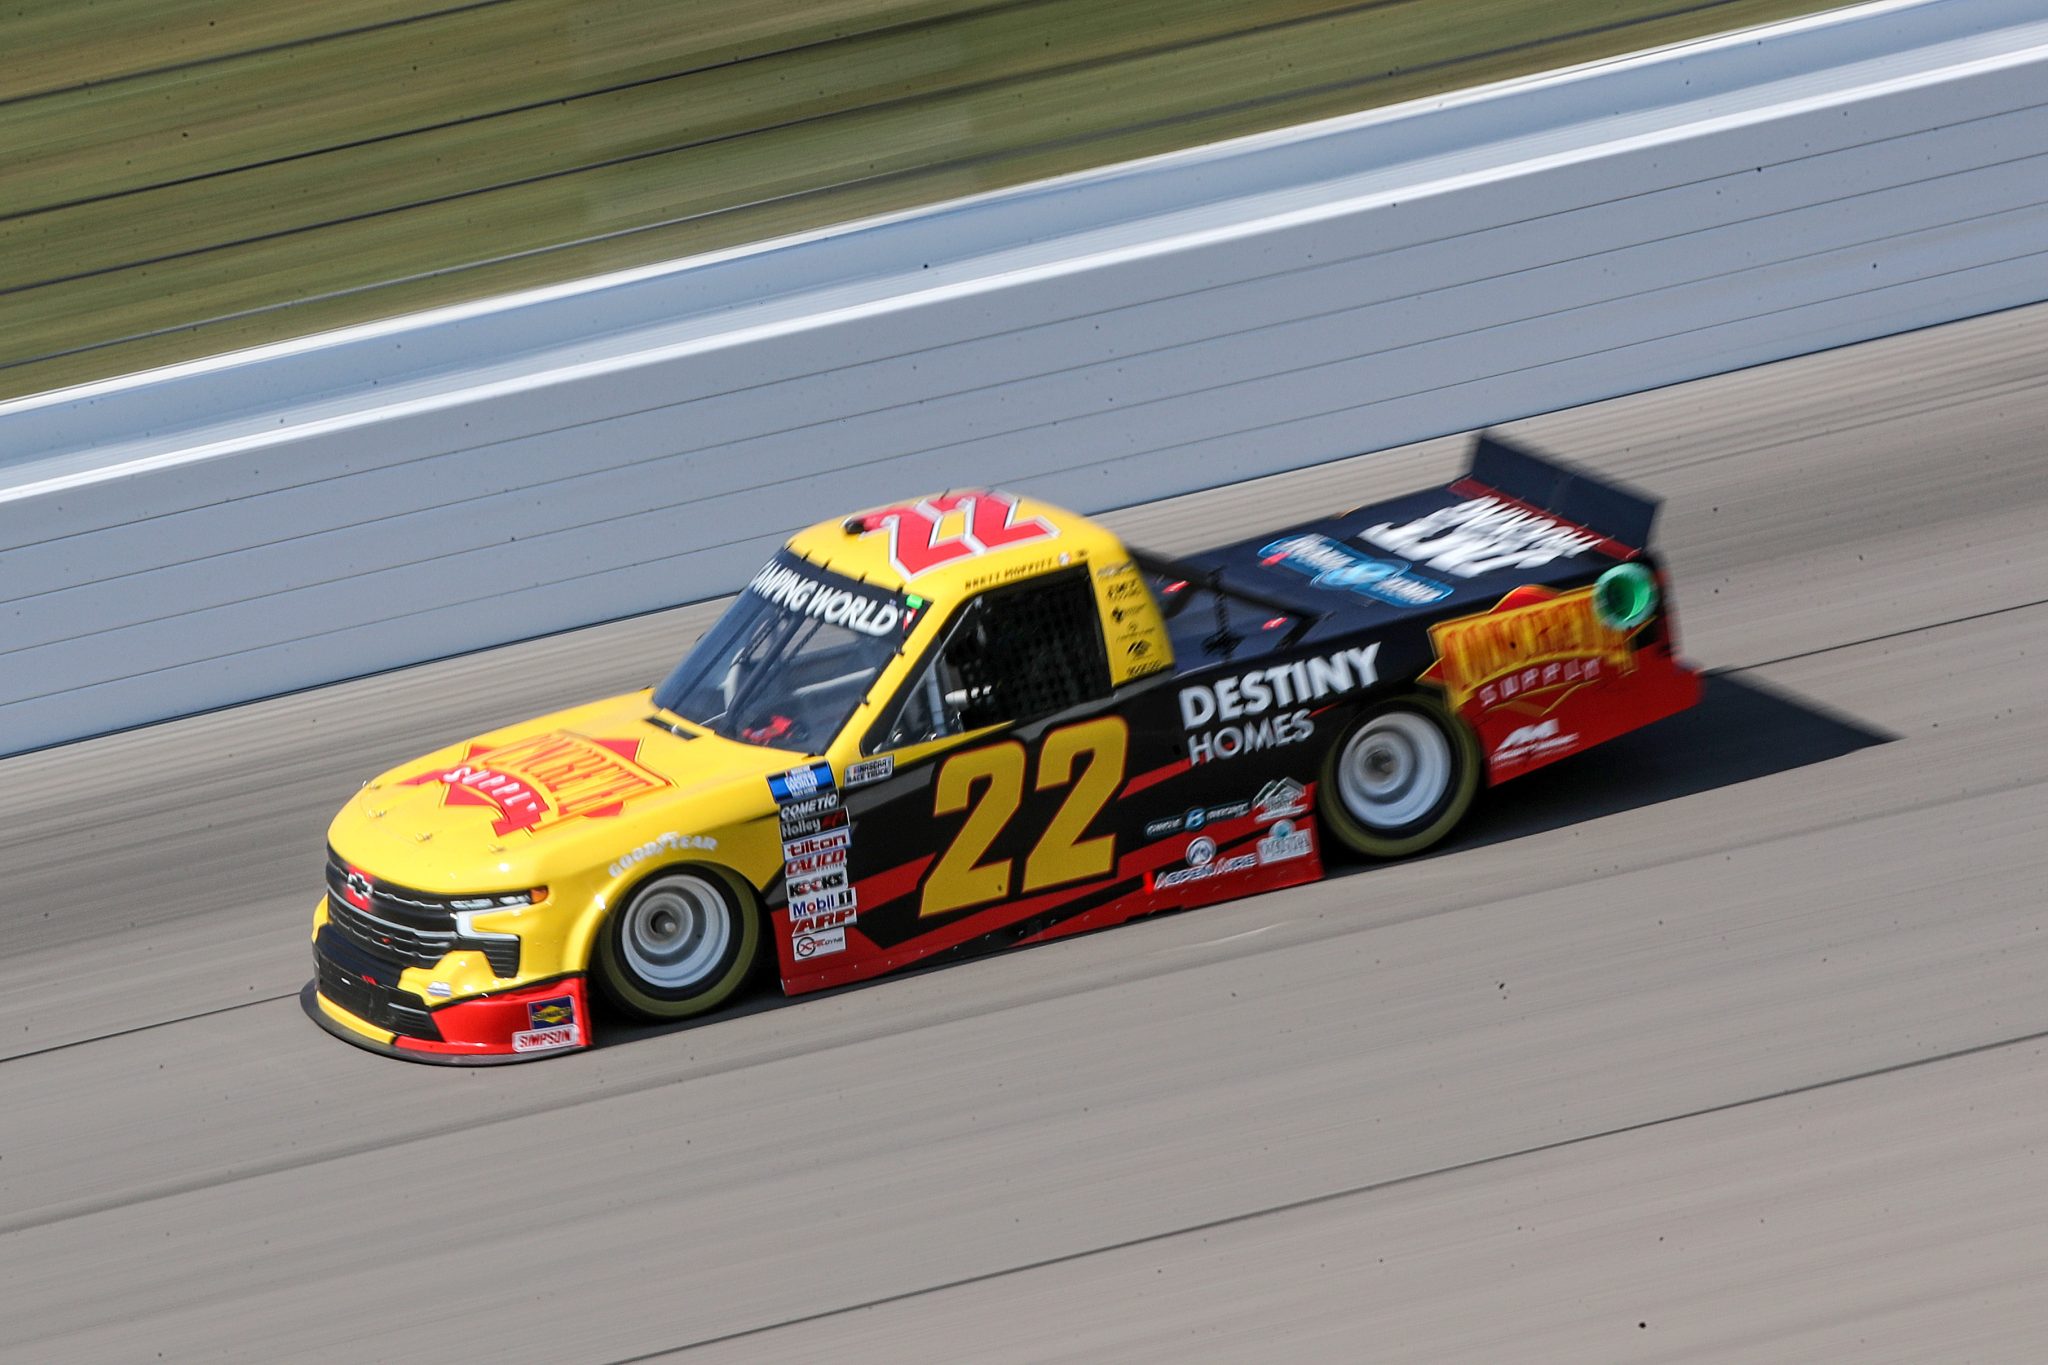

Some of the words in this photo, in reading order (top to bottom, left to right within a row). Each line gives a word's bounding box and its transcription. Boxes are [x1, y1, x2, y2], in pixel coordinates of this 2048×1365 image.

[840, 490, 1061, 584] 22
[805, 584, 898, 637] WORLD
[1178, 641, 1381, 731] DESTINY
[1187, 708, 1315, 767] HOMES
[781, 818, 821, 839] Holley
[918, 714, 1129, 919] 22
[787, 833, 847, 858] tilton
[792, 894, 835, 918] Mobil
[793, 908, 855, 934] ARP
[519, 1029, 571, 1048] SIMPSON
